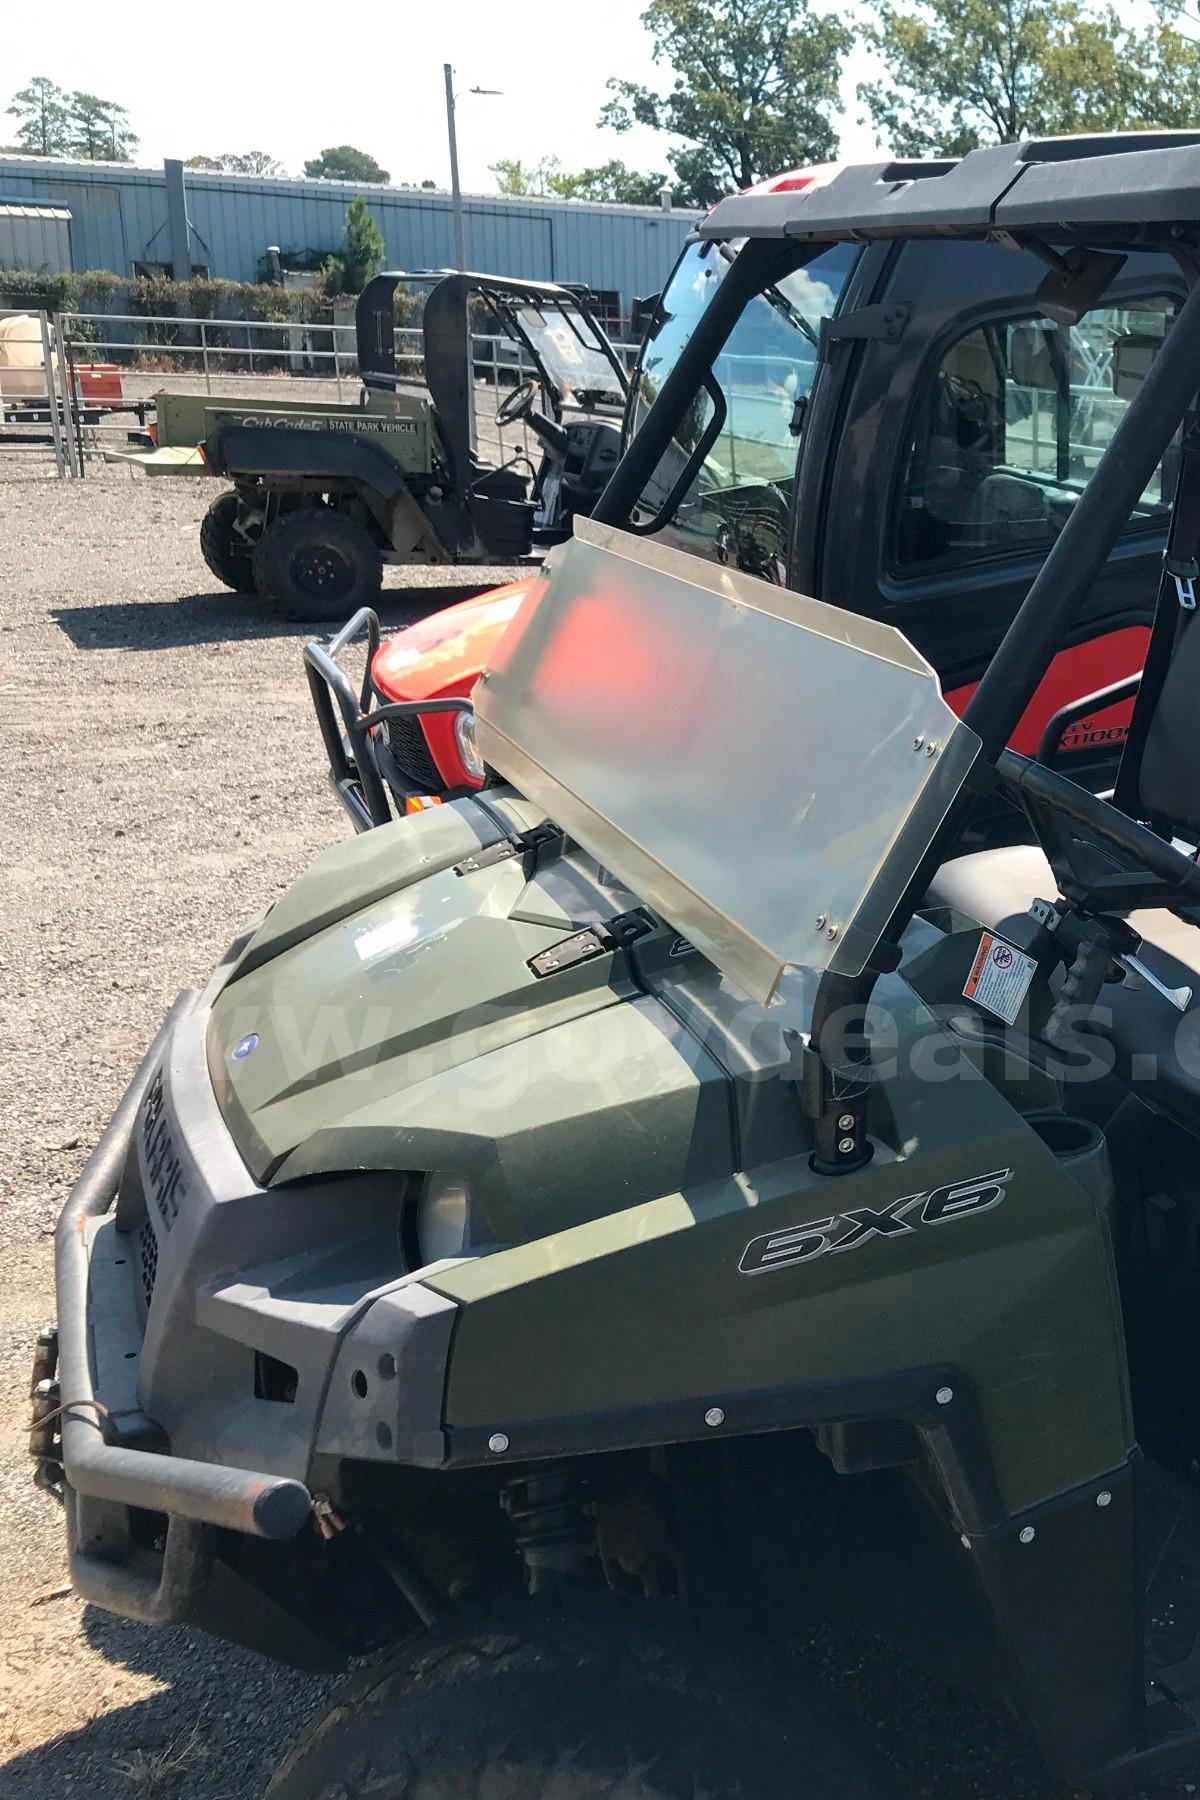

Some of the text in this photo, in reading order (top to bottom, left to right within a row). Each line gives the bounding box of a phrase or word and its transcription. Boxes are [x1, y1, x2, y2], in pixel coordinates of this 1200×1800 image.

[241, 416, 323, 431] Cub Cadet
[329, 419, 417, 433] STATE PARK VEHICLE
[975, 945, 988, 976] WARNING
[738, 1167, 1015, 1276] 6X6
